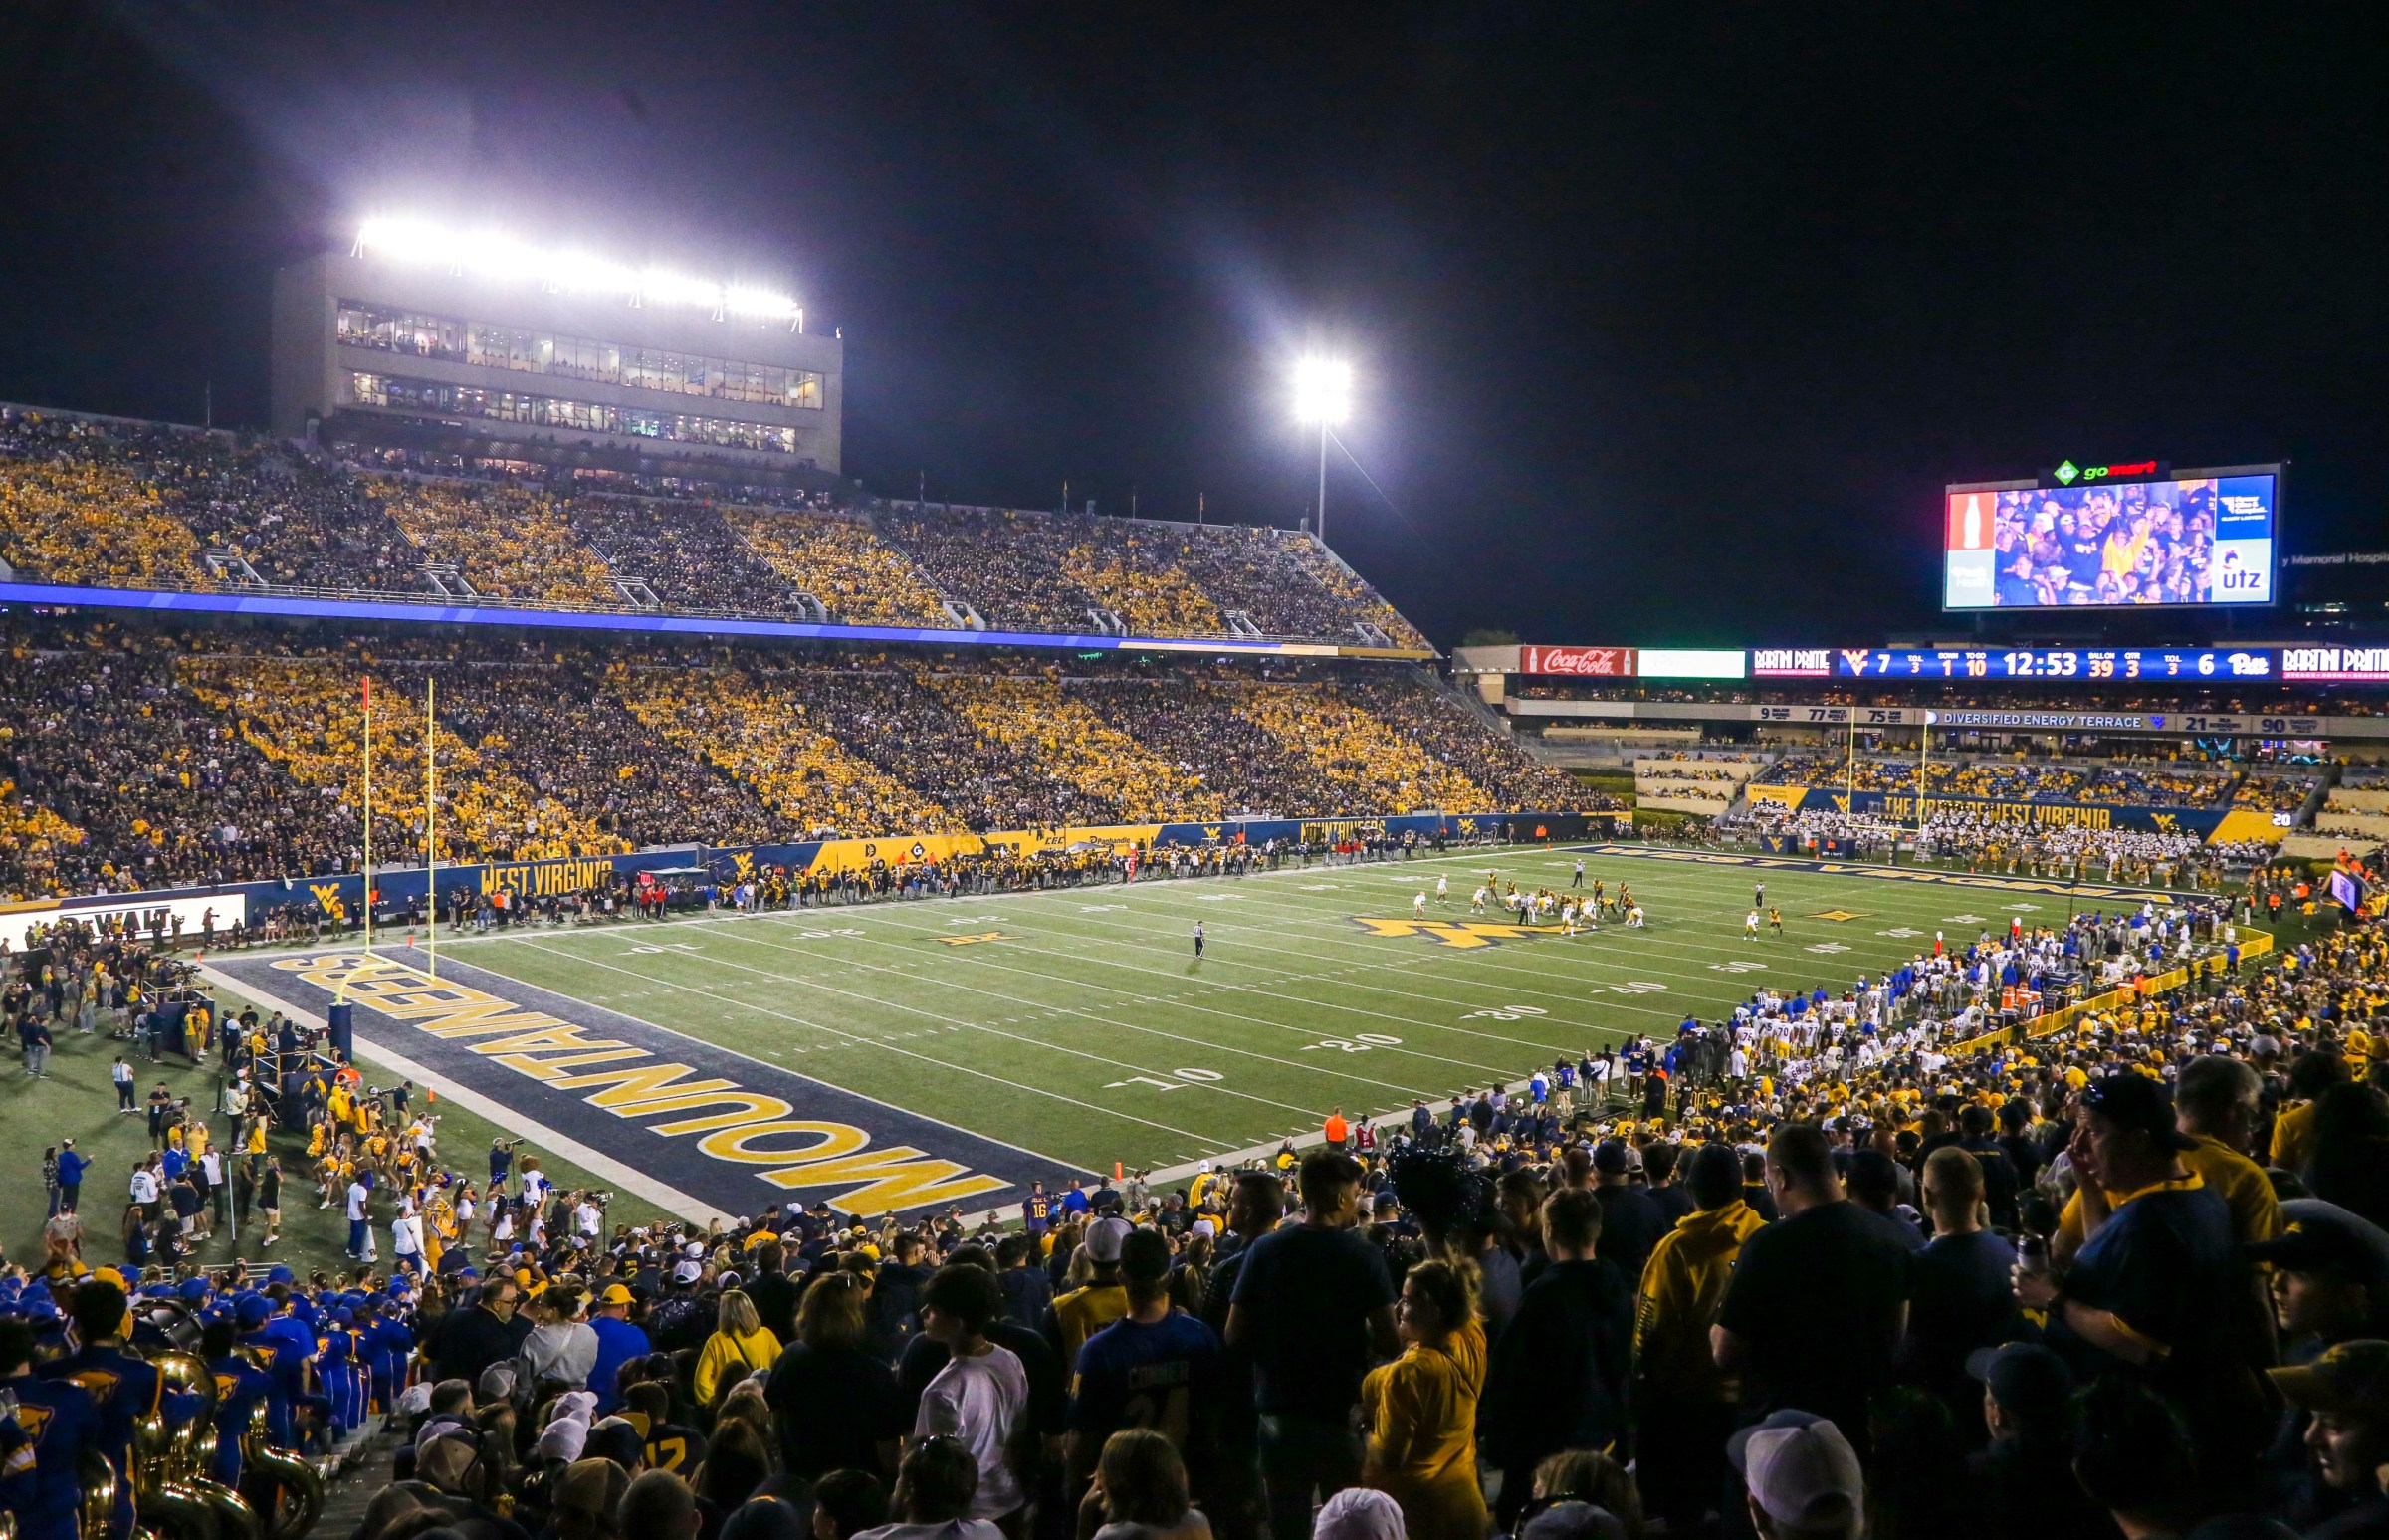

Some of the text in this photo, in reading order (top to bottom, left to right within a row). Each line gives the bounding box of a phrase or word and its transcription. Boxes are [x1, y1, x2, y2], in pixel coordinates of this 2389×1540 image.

[2223, 569, 2261, 588] utz
[1544, 649, 1617, 674] Coca-Cola
[1794, 650, 1831, 669] PRIME
[1877, 653, 1891, 673] 7
[1910, 662, 1920, 674] 3
[1942, 659, 1952, 676] 1
[1966, 659, 1988, 676] 10
[2003, 652, 2077, 676] 12:53
[2125, 659, 2139, 677] 3
[2198, 653, 2215, 675] 6
[2088, 660, 2114, 677] 39
[2167, 662, 2178, 675] 3
[1761, 708, 1770, 719] 9
[1809, 709, 1826, 721] 77
[1868, 710, 1886, 723] 75
[1944, 713, 2142, 728] DIVERSIFIED ENERGY TERRACE
[2185, 717, 2206, 731] 21
[2261, 718, 2285, 733] 90
[2034, 805, 2111, 829] VIRGINIA
[2272, 813, 2291, 826] 20
[1300, 820, 1387, 843] MOUNTAINS
[481, 864, 530, 898] WEST
[1818, 863, 2175, 904] VIRGINIA
[60, 908, 171, 935] DWALT
[1608, 981, 1668, 994] 40
[1473, 1004, 1549, 1021] 30
[1778, 1027, 1789, 1036] 70
[1318, 1032, 1403, 1054] 20
[269, 953, 1016, 1219] MOUNTAINEERS
[1125, 1067, 1224, 1092] 10
[1032, 1203, 1047, 1218] 16
